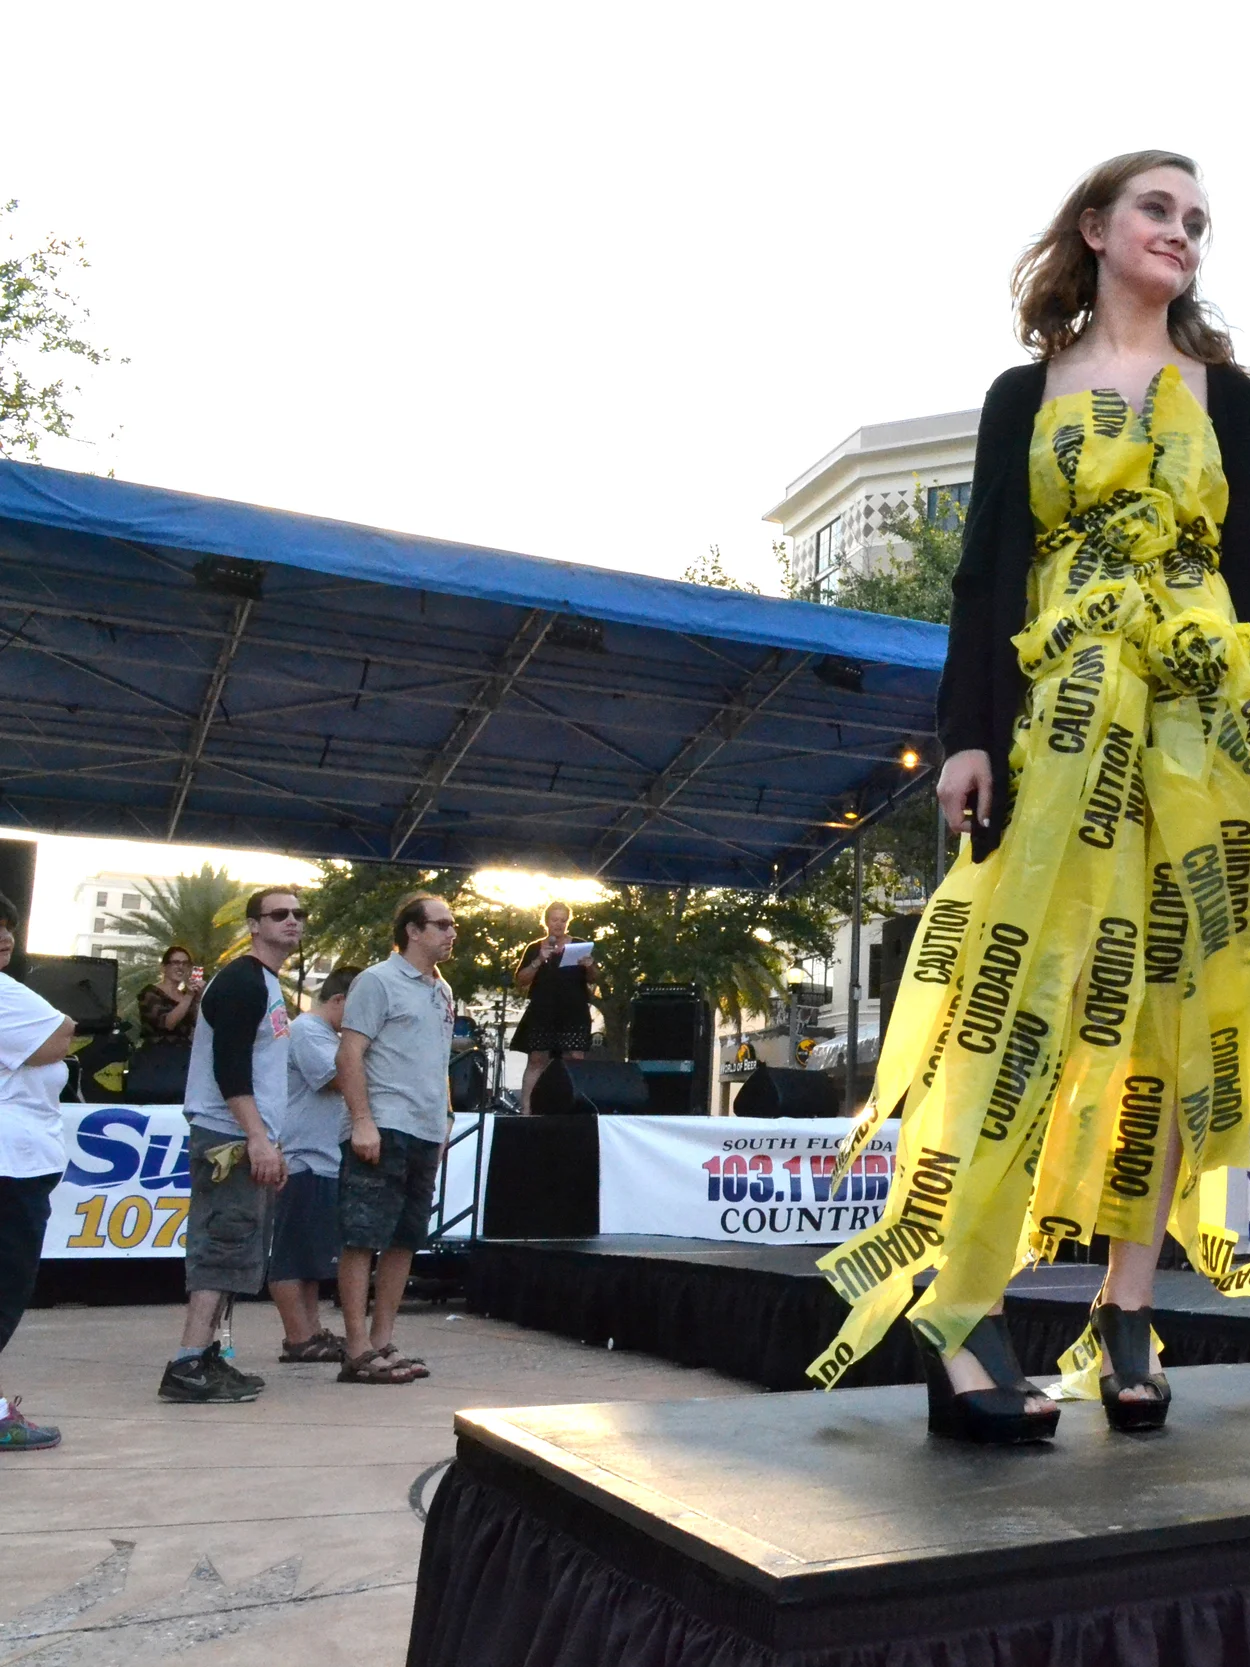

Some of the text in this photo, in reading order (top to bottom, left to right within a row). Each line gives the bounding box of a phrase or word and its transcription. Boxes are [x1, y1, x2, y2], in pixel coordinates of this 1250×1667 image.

[1048, 644, 1105, 754] CAUTION
[1078, 721, 1134, 850] CAUTION
[913, 898, 973, 986] CAUTION
[1145, 861, 1189, 984] CAUTION
[957, 922, 1029, 1055] CUIDADO
[1079, 917, 1138, 1047] CUIDADO
[980, 1010, 1050, 1142] CUIDADO
[702, 1154, 895, 1203] 103.1 WIR
[723, 1137, 796, 1152] SOUTH
[1110, 1075, 1165, 1197] CUIDADO
[720, 1206, 888, 1234] COUNTRY
[1199, 1232, 1237, 1275] AUT
